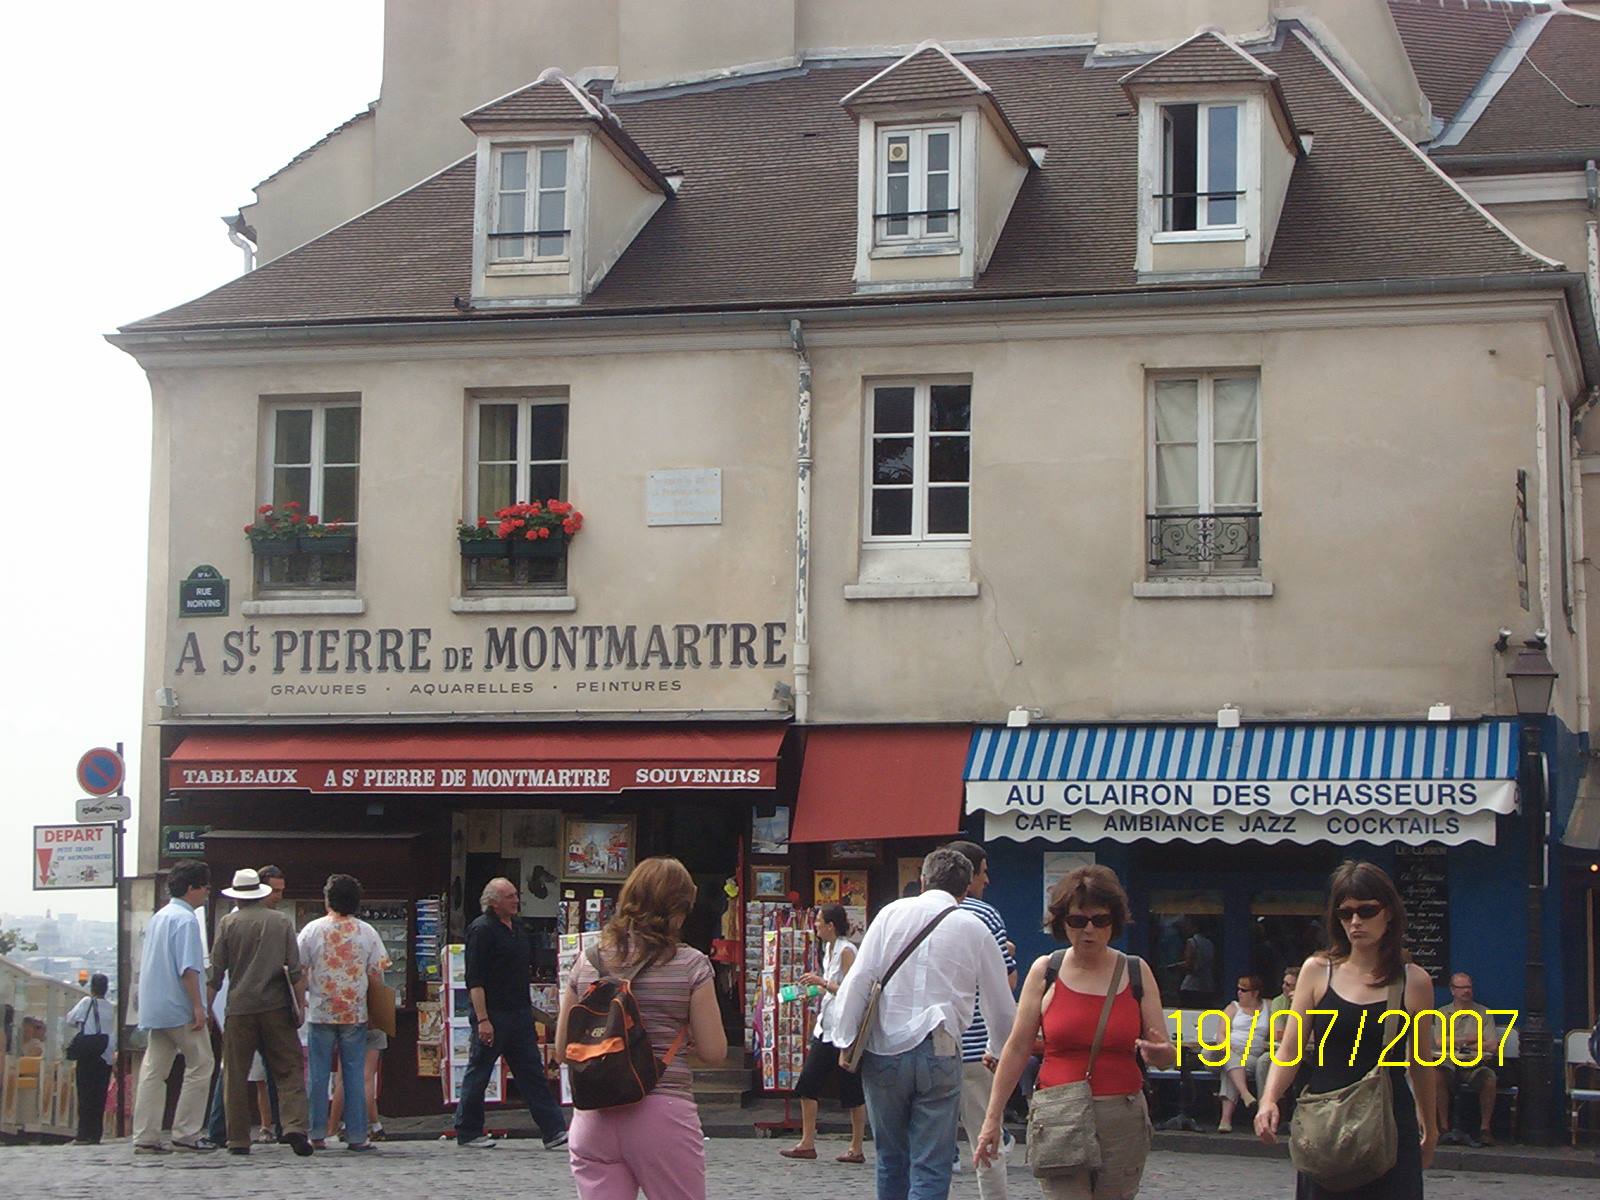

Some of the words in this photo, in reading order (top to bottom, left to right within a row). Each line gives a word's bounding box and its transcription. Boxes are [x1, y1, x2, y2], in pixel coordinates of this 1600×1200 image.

[195, 587, 213, 597] RUE
[186, 599, 221, 608] NORVINS
[175, 631, 206, 674] A
[271, 627, 432, 674] PIERRE
[442, 646, 474, 672] DE
[483, 622, 788, 671] MONTMARTRE
[270, 684, 367, 696] GRAVURES
[410, 682, 534, 695] AQUARELLES
[576, 680, 682, 693] PEINTURES
[183, 769, 298, 784] TABLEAUX
[323, 769, 337, 787] A
[364, 769, 436, 788] PIERRE
[440, 769, 466, 787] DE
[471, 768, 611, 787] MONTMARTRE
[636, 768, 761, 784] SOUVENIRS
[1005, 784, 1045, 806] AU
[1063, 784, 1193, 806] CLAIRON
[1213, 784, 1271, 806] DES
[1290, 783, 1478, 806] CHASSEURS
[1015, 814, 1072, 832] CAFE
[1103, 815, 1225, 832] AMBIANCE
[1238, 816, 1297, 833] JAZZ
[1326, 816, 1460, 835] COCKTAILS
[44, 827, 104, 843] DEPART
[178, 831, 196, 840] RUE
[168, 841, 206, 850] NORVINS
